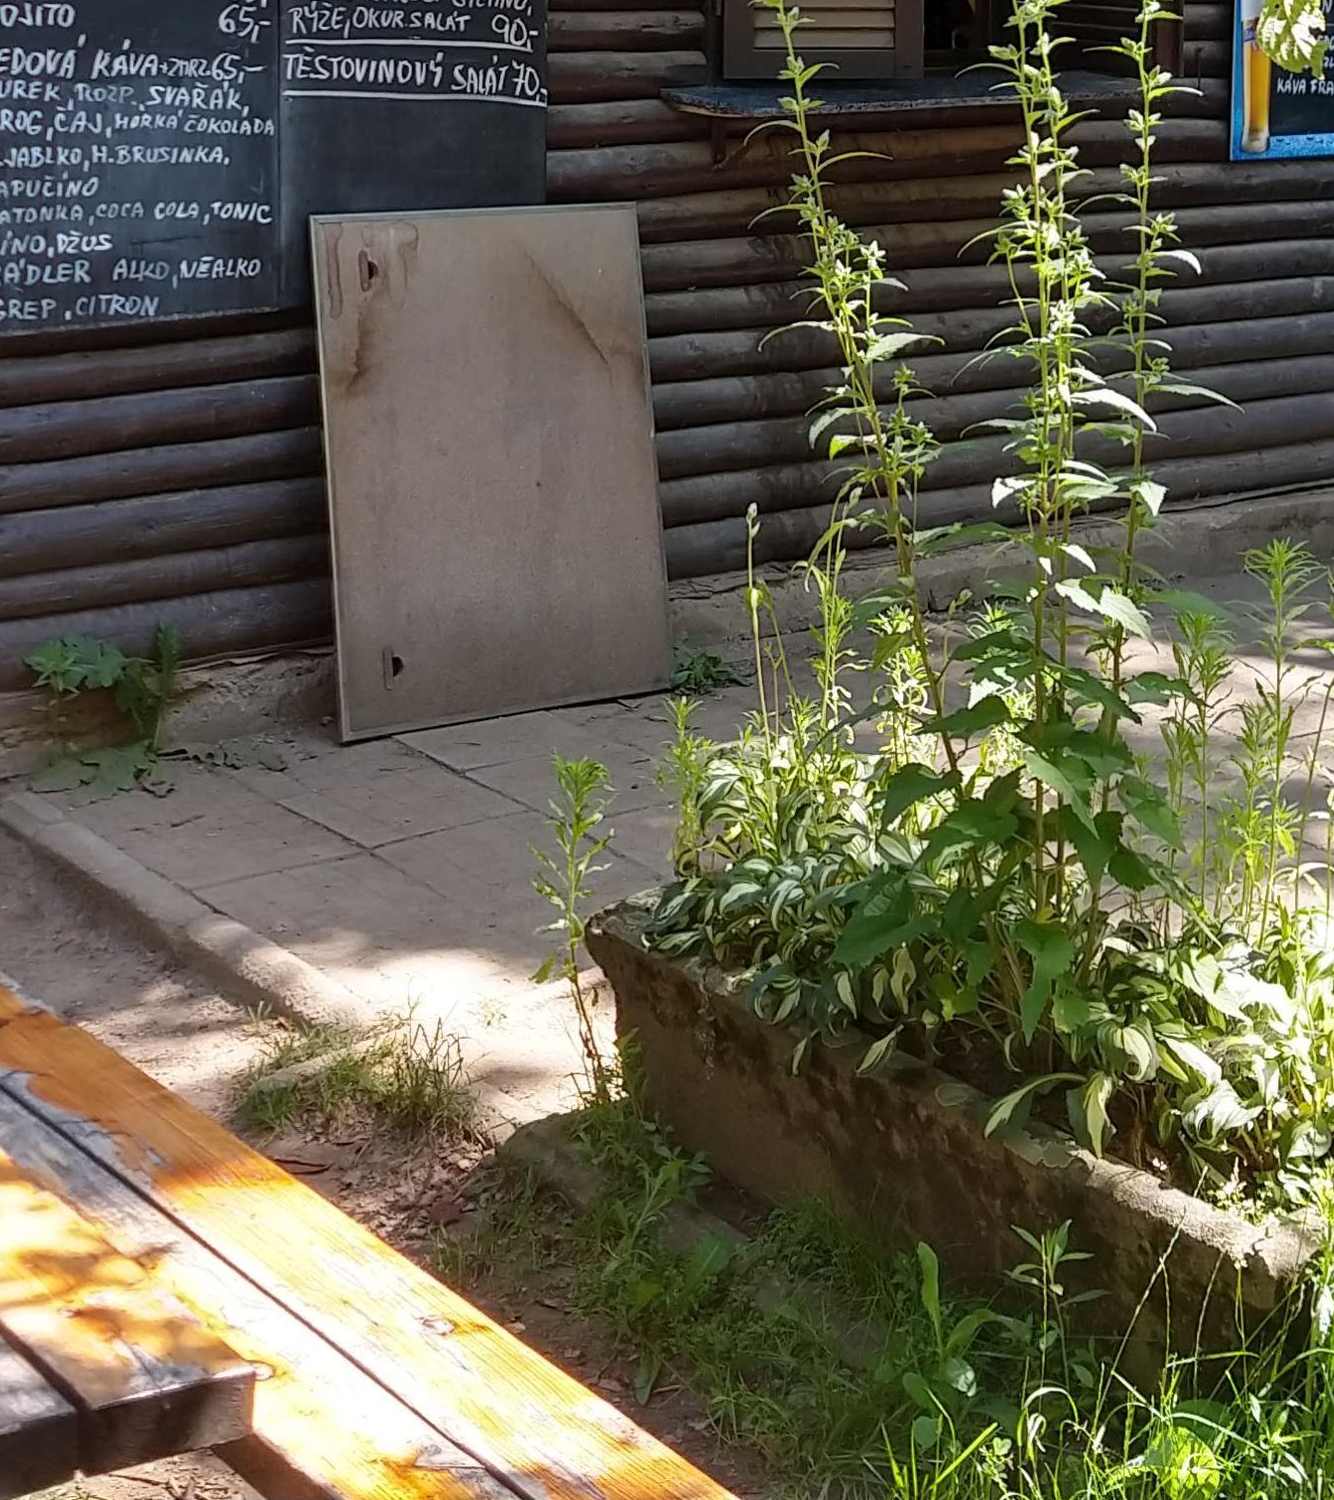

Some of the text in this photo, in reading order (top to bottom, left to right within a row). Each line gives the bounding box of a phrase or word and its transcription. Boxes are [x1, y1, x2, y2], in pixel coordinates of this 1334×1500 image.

[409, 10, 472, 33] SALÁT
[282, 46, 444, 88] TĚSTOVINOVÝ
[450, 54, 509, 94] SALÁT
[1277, 72, 1306, 94] KÁVA
[115, 109, 184, 131] HORKÁ
[95, 202, 145, 220] COCA
[210, 201, 274, 225] TONIC
[55, 230, 114, 254] DŽUS
[179, 255, 262, 280] NEALKO
[74, 293, 160, 318] CITRON
